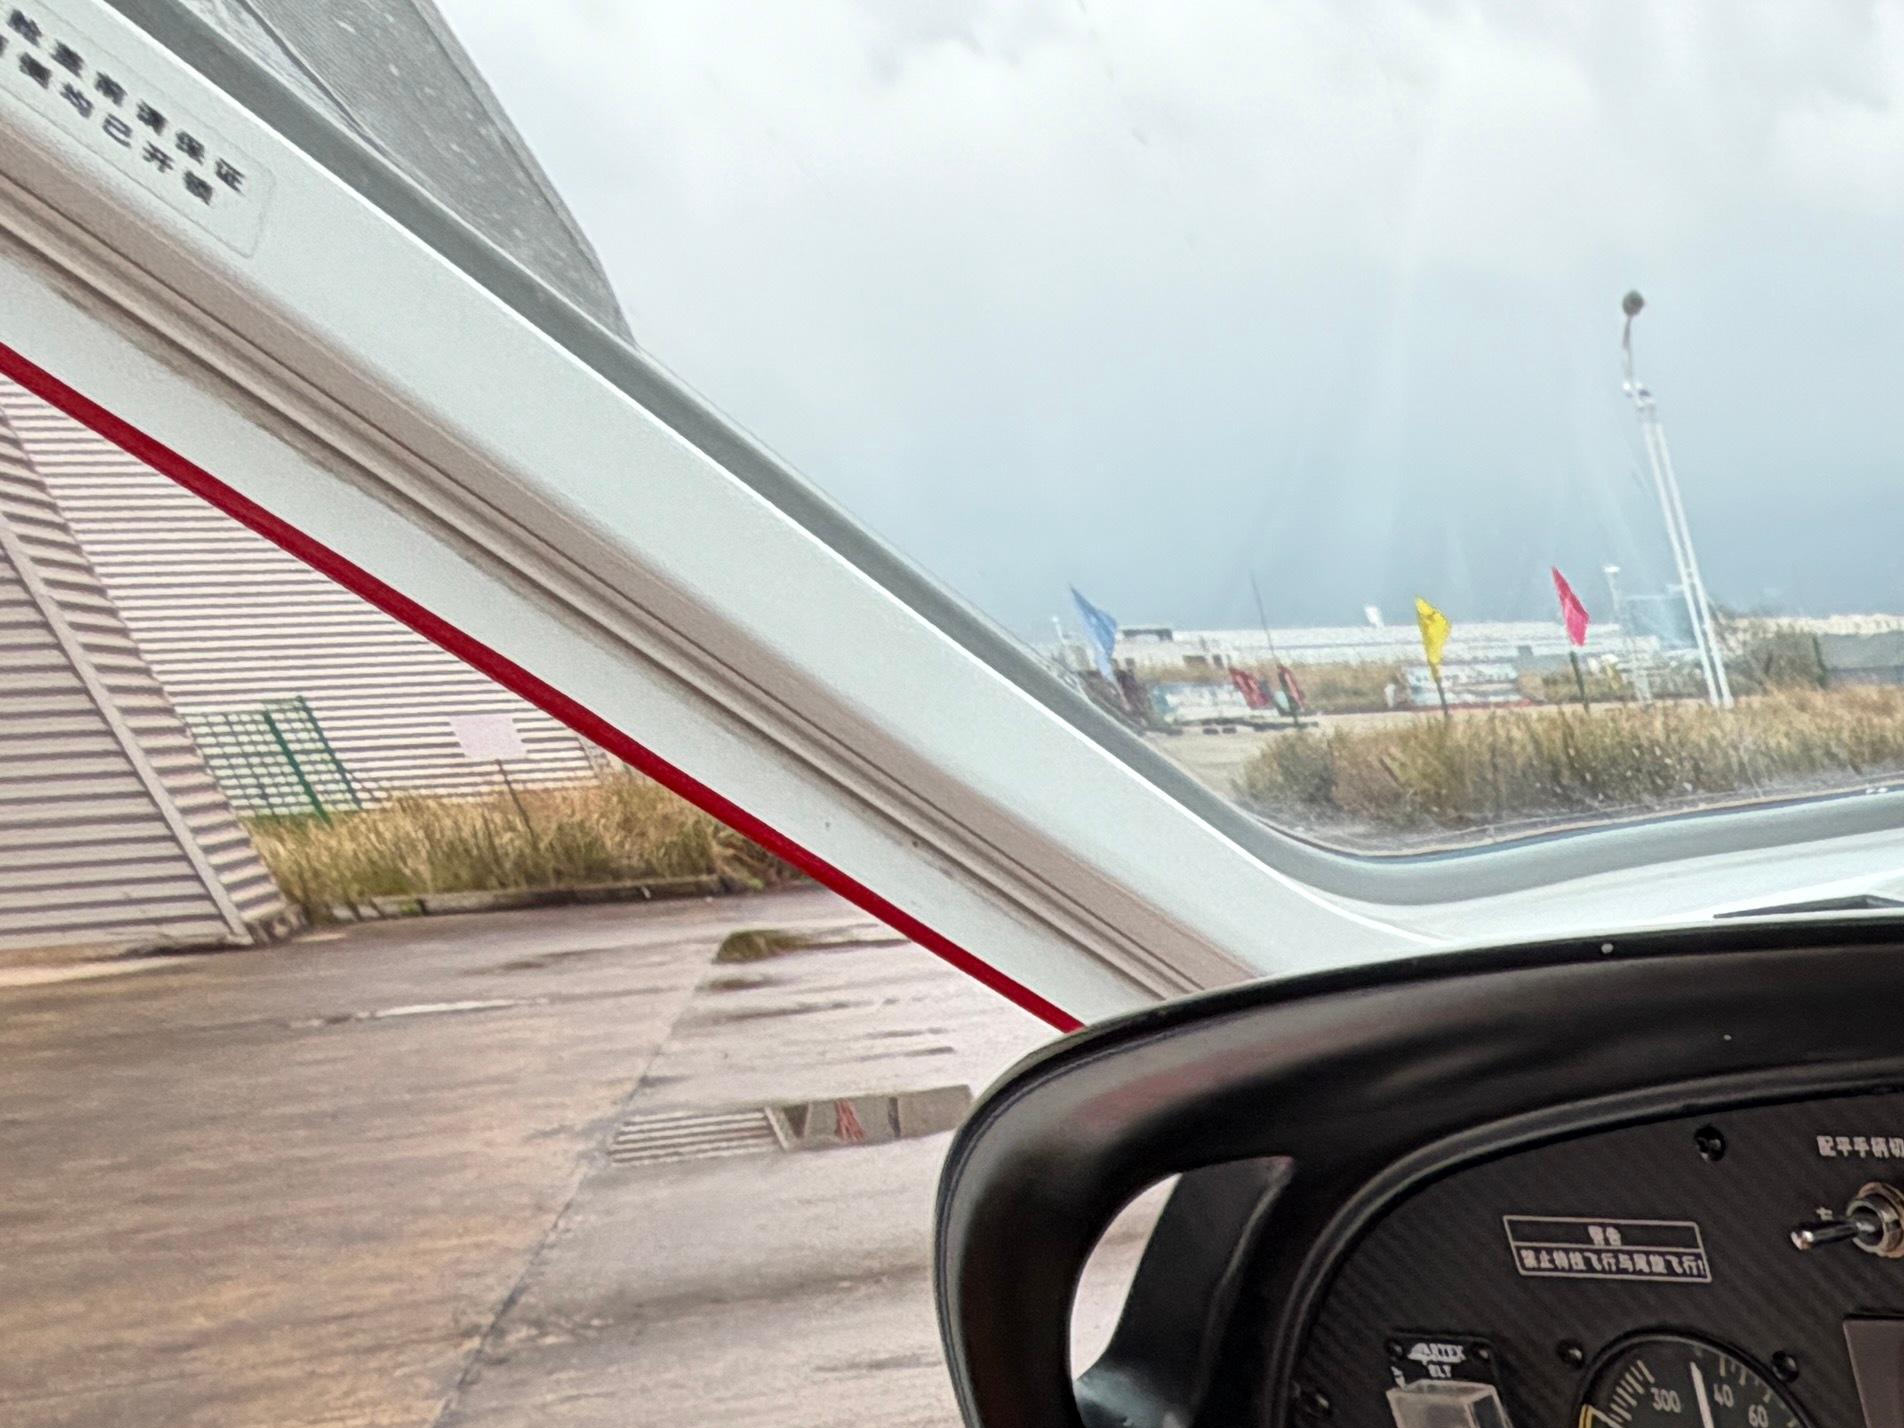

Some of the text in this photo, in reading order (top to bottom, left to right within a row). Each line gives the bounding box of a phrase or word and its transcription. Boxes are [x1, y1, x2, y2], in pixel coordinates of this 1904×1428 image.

[1650, 1387, 1682, 1413] 300
[1714, 1384, 1734, 1408] 40
[1748, 1405, 1769, 1428] 60
